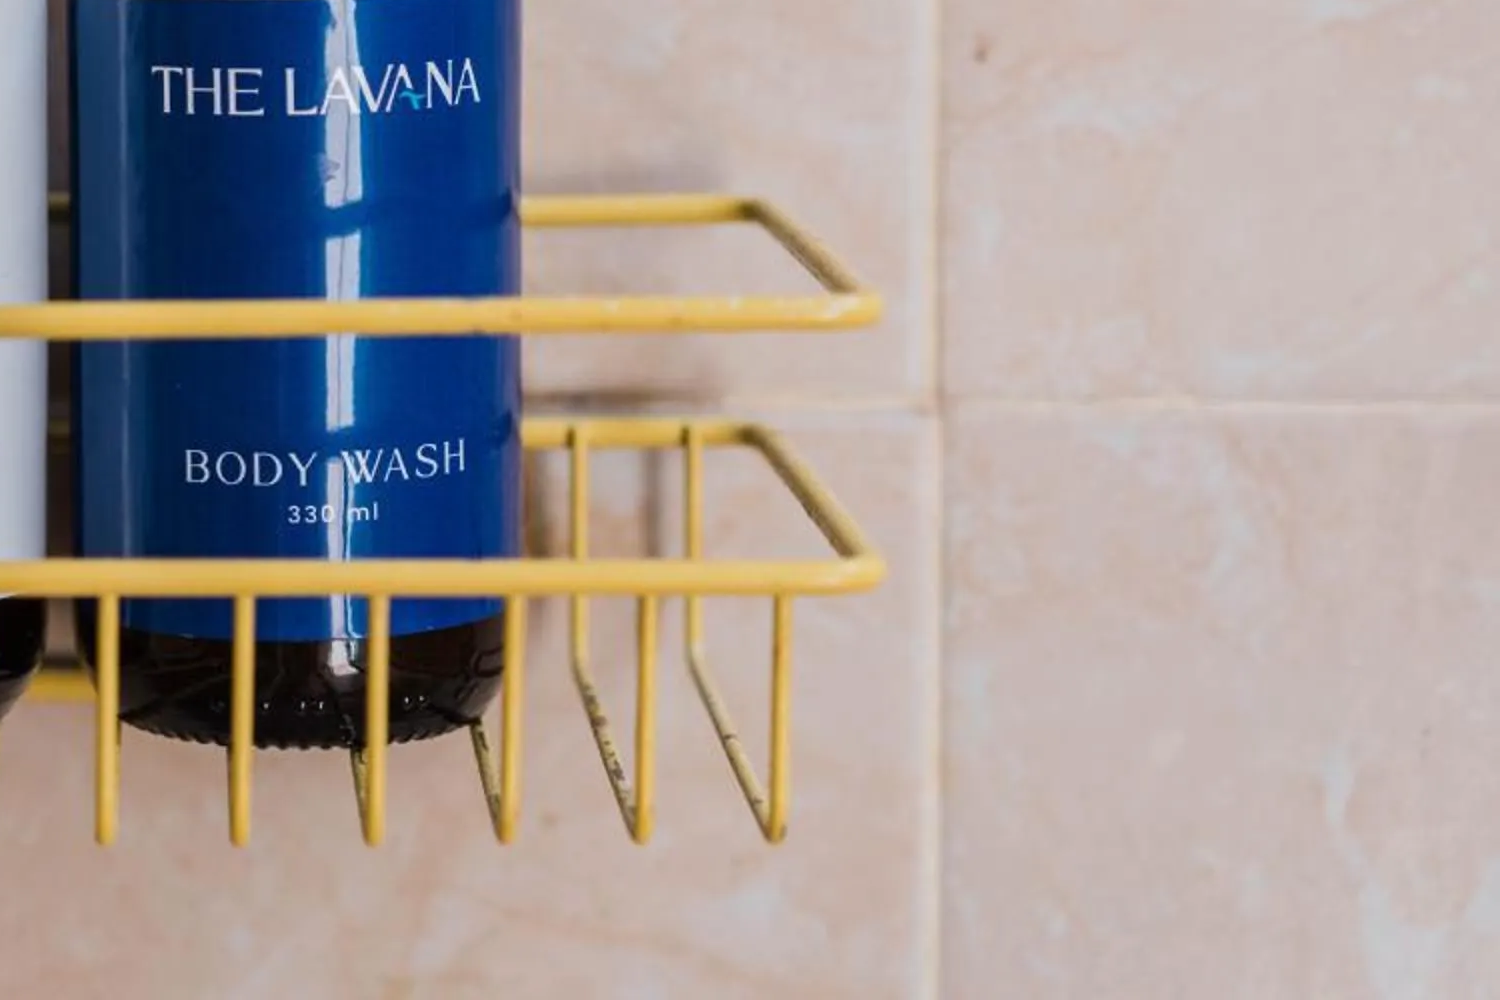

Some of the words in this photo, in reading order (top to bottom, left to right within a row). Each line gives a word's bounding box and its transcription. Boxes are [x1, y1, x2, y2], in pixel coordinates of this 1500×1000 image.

[150, 65, 265, 117] THE
[284, 57, 481, 117] LAVANA
[185, 449, 318, 487] BODY
[340, 438, 466, 485] WASH
[287, 504, 335, 524] 330
[347, 502, 379, 522] ml
